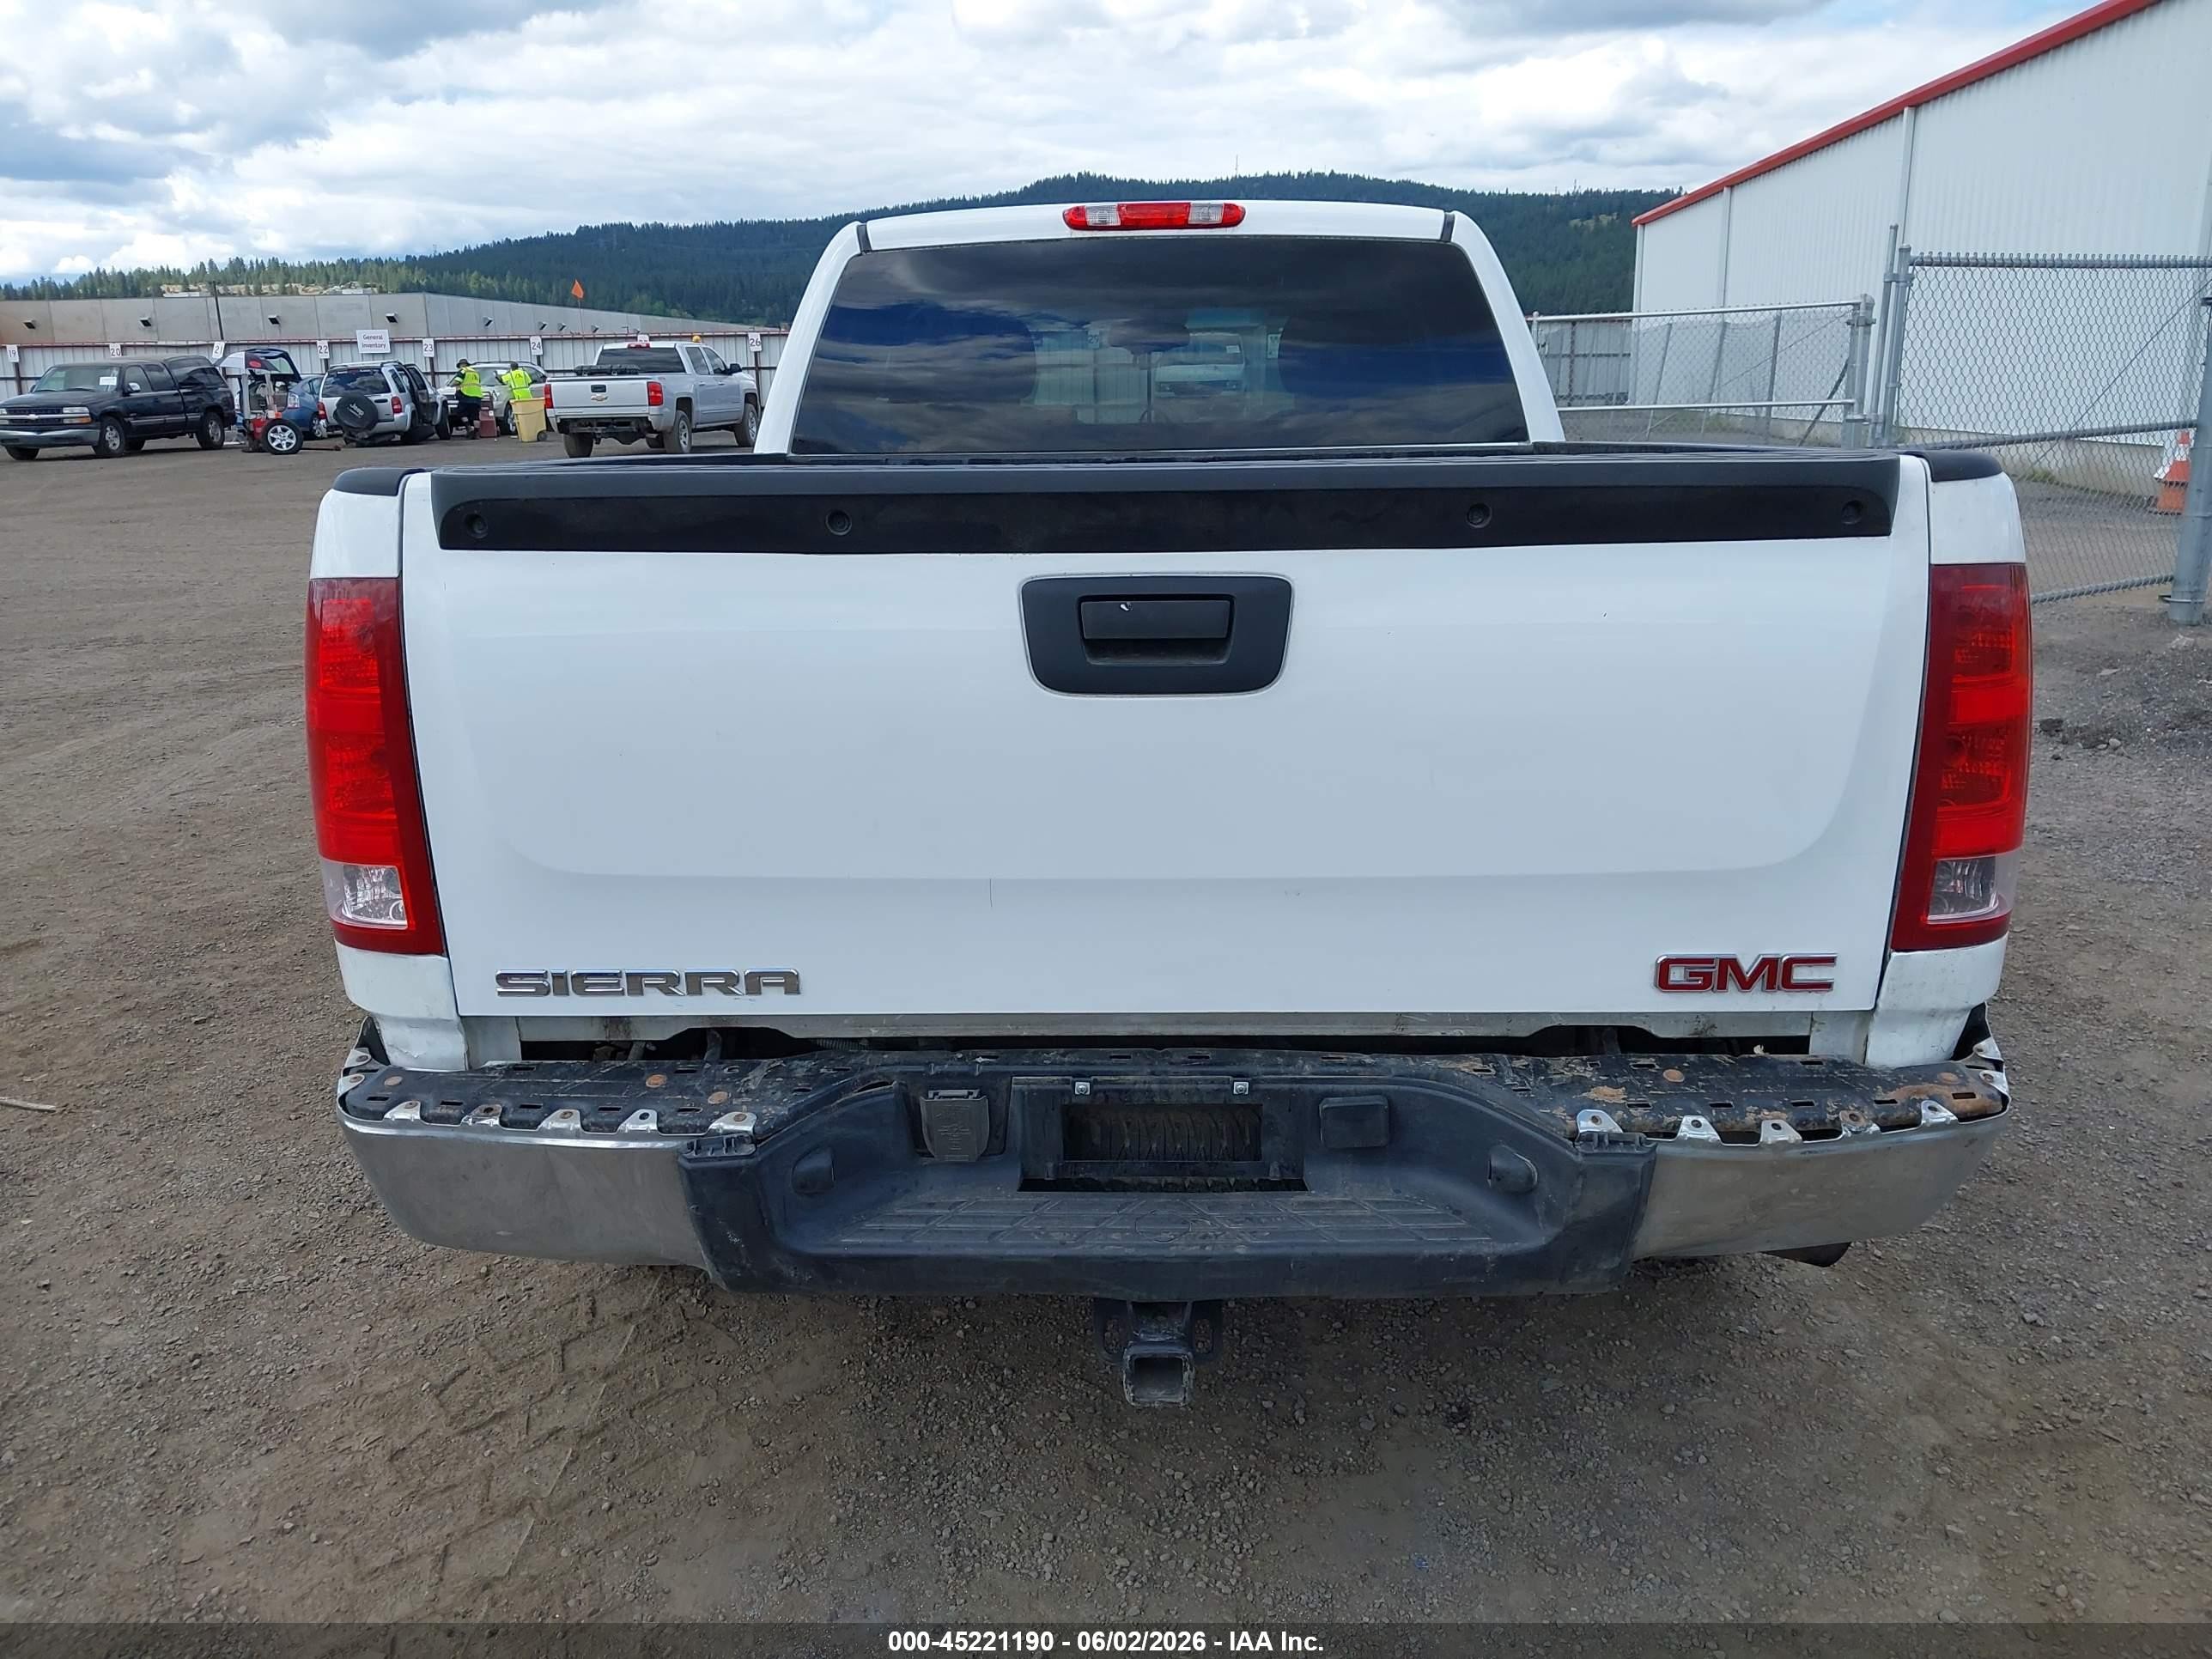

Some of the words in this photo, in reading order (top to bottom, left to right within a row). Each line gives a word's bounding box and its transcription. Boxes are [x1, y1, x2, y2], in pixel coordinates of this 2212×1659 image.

[749, 338, 760, 347] 26
[215, 343, 222, 354] 21
[318, 345, 328, 354] 22
[424, 343, 433, 352] 23
[9, 349, 16, 358] 19
[110, 348, 120, 357] 20
[1654, 953, 1838, 994] GMC
[495, 969, 801, 996] SIERRA
